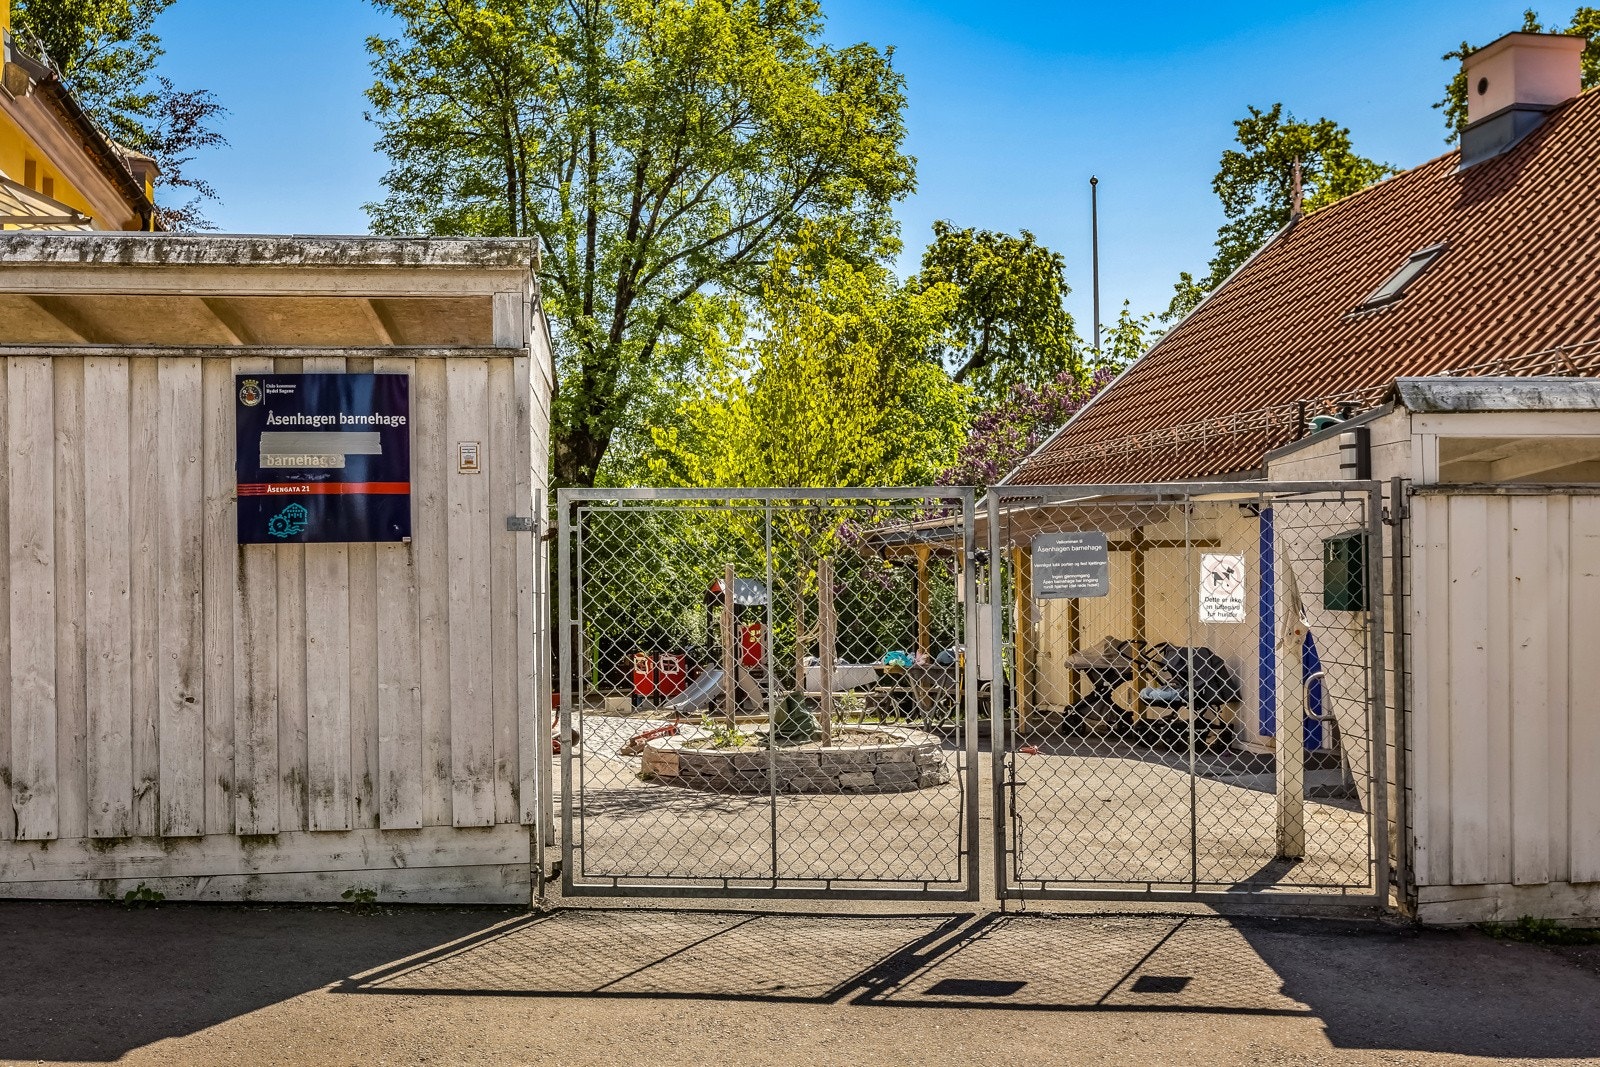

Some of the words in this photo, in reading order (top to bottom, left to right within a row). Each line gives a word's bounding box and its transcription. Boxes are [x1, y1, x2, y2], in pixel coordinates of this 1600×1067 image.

[266, 410, 336, 427] Åsenhagen
[340, 413, 406, 427] barnehage
[267, 455, 337, 468] barnehage
[267, 485, 300, 493] ÅSENGATA
